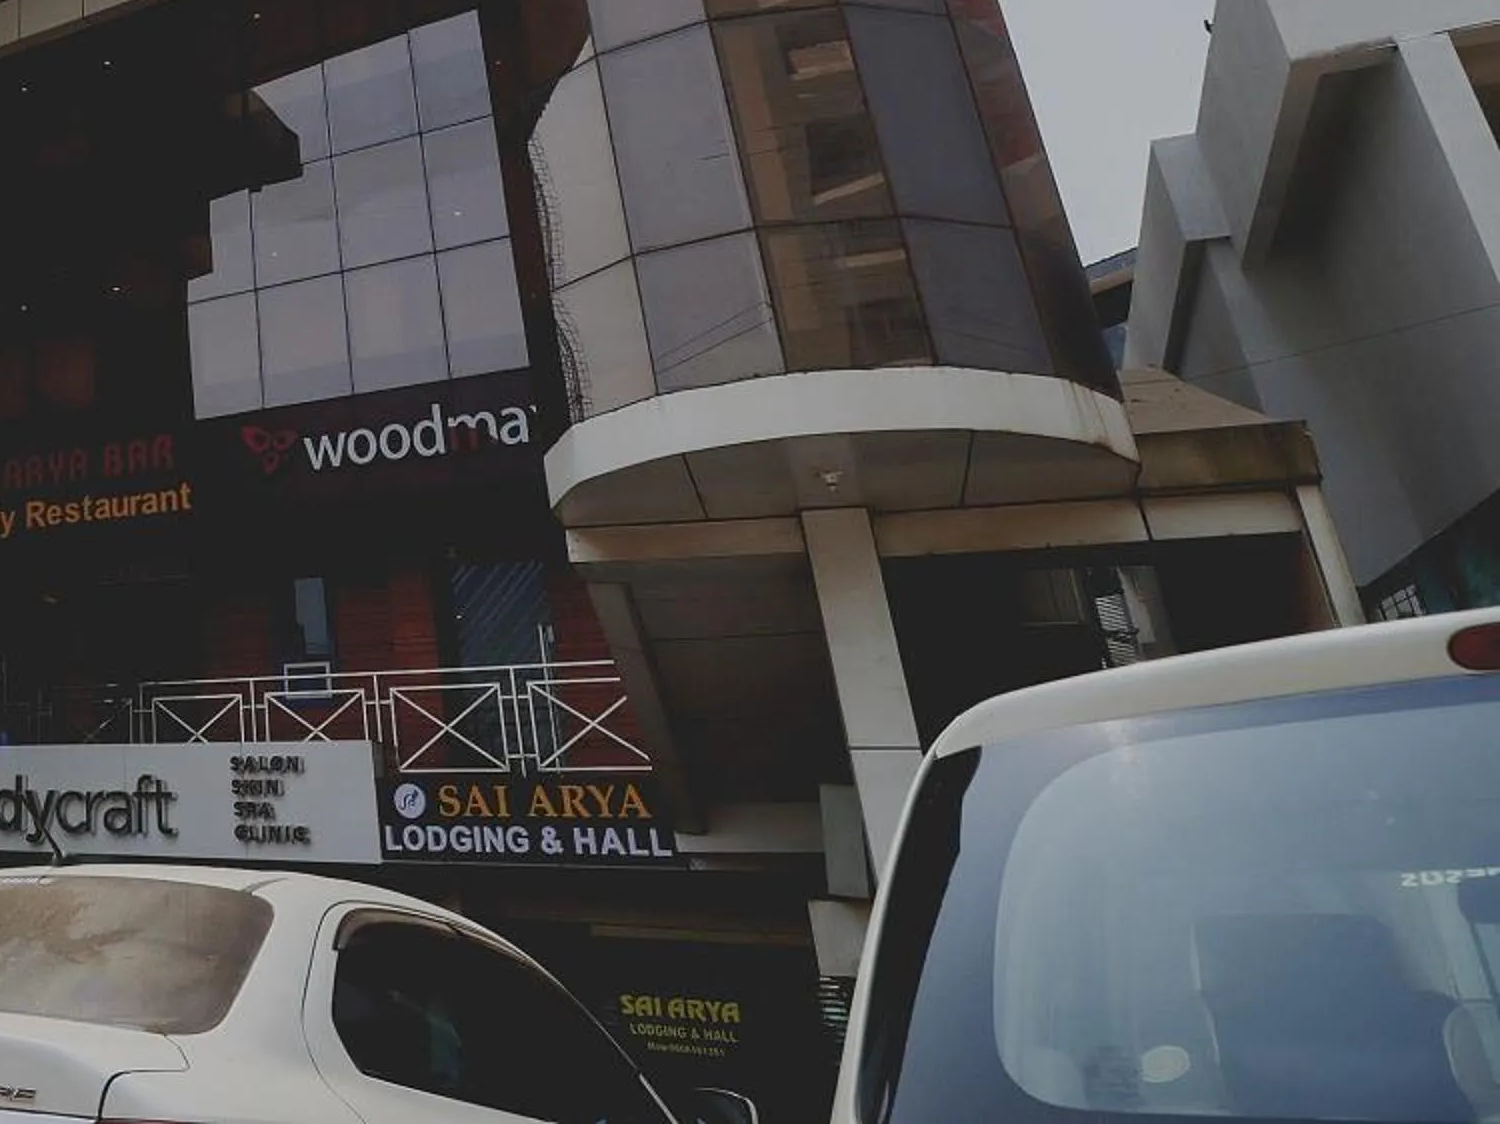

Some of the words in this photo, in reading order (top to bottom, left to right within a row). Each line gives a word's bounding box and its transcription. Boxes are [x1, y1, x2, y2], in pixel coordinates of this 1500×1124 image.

[303, 403, 537, 471] woodma
[4, 447, 88, 489] ARYA
[103, 433, 175, 478] BAR
[25, 481, 193, 530] Restaurant
[229, 755, 304, 774] SALON
[231, 779, 284, 797] SKIN
[438, 784, 511, 818] SAI
[527, 784, 652, 819] ARYA
[234, 824, 311, 845] CLINIC
[385, 825, 530, 853] LODGING
[541, 826, 563, 854] &
[573, 827, 673, 857] HALL
[619, 992, 663, 1018] SAI
[667, 996, 742, 1025] ARYA
[630, 1023, 688, 1040] LODGING
[703, 1028, 741, 1044] HALL
